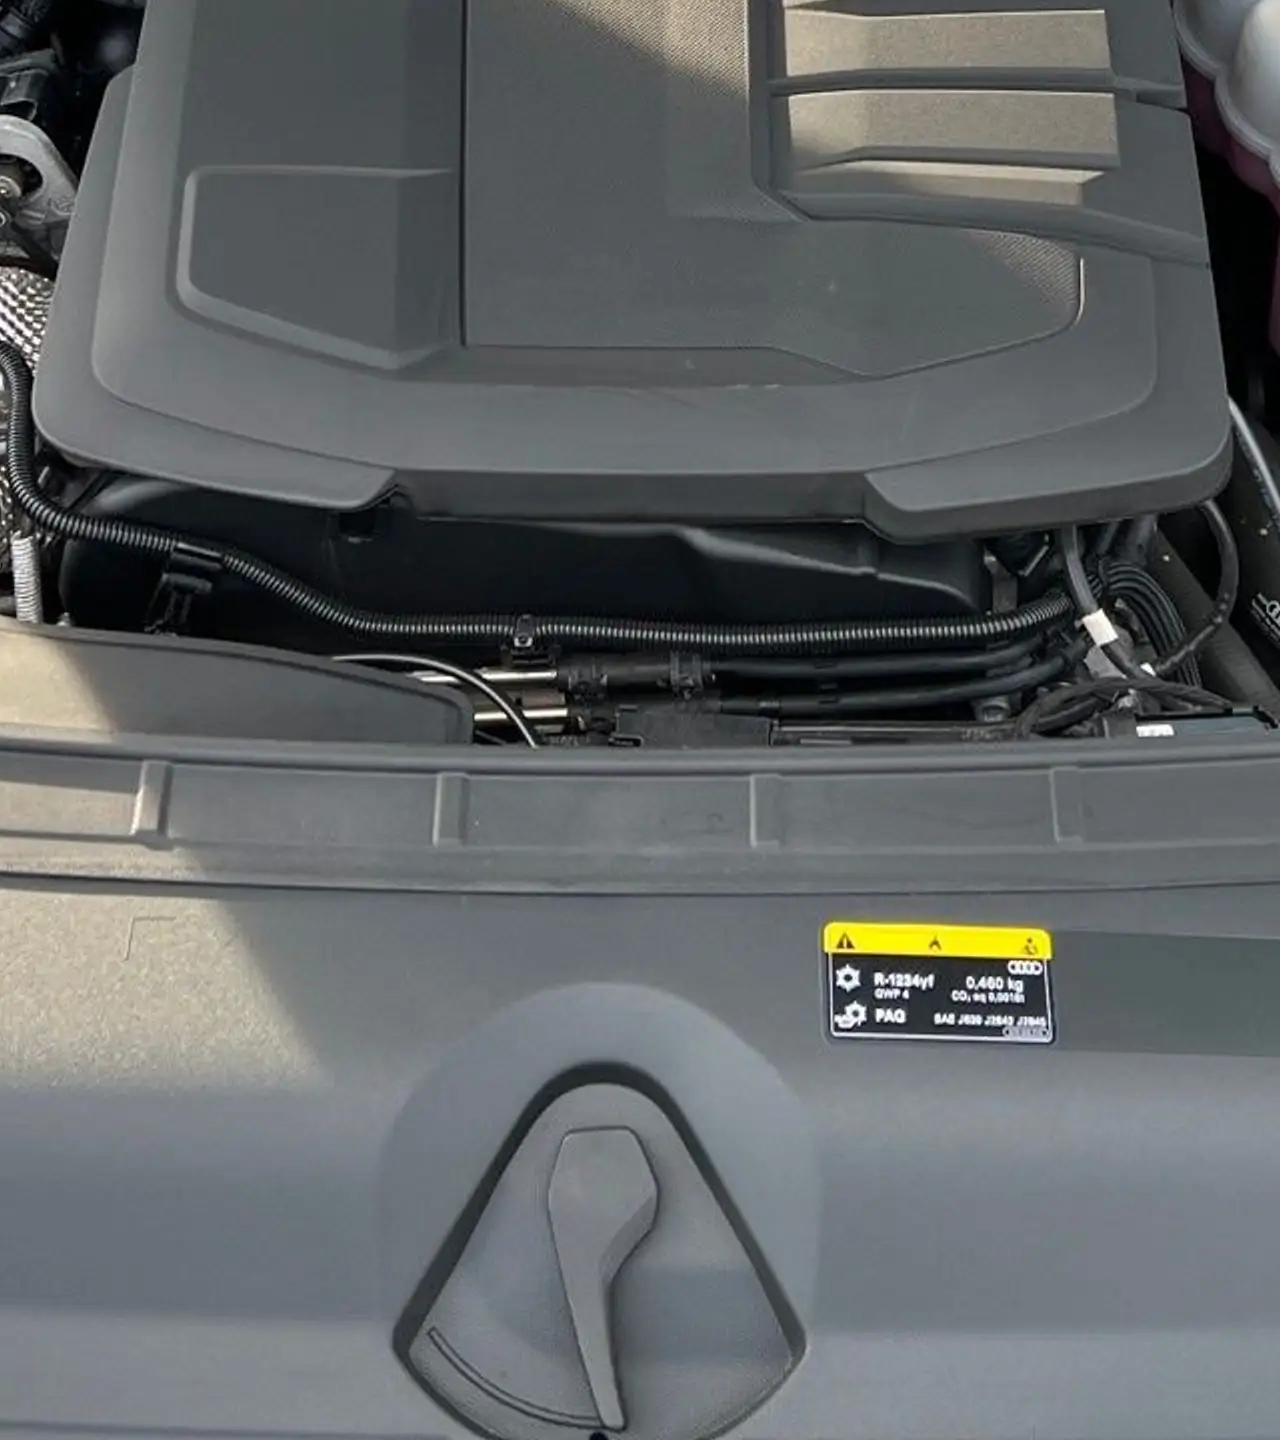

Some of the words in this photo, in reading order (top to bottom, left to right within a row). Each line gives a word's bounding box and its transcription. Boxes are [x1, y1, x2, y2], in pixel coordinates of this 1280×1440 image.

[873, 971, 935, 990] R-1234yf
[1006, 976, 1025, 993] kg
[874, 987, 901, 1000] GWP
[875, 1007, 907, 1024] PAG
